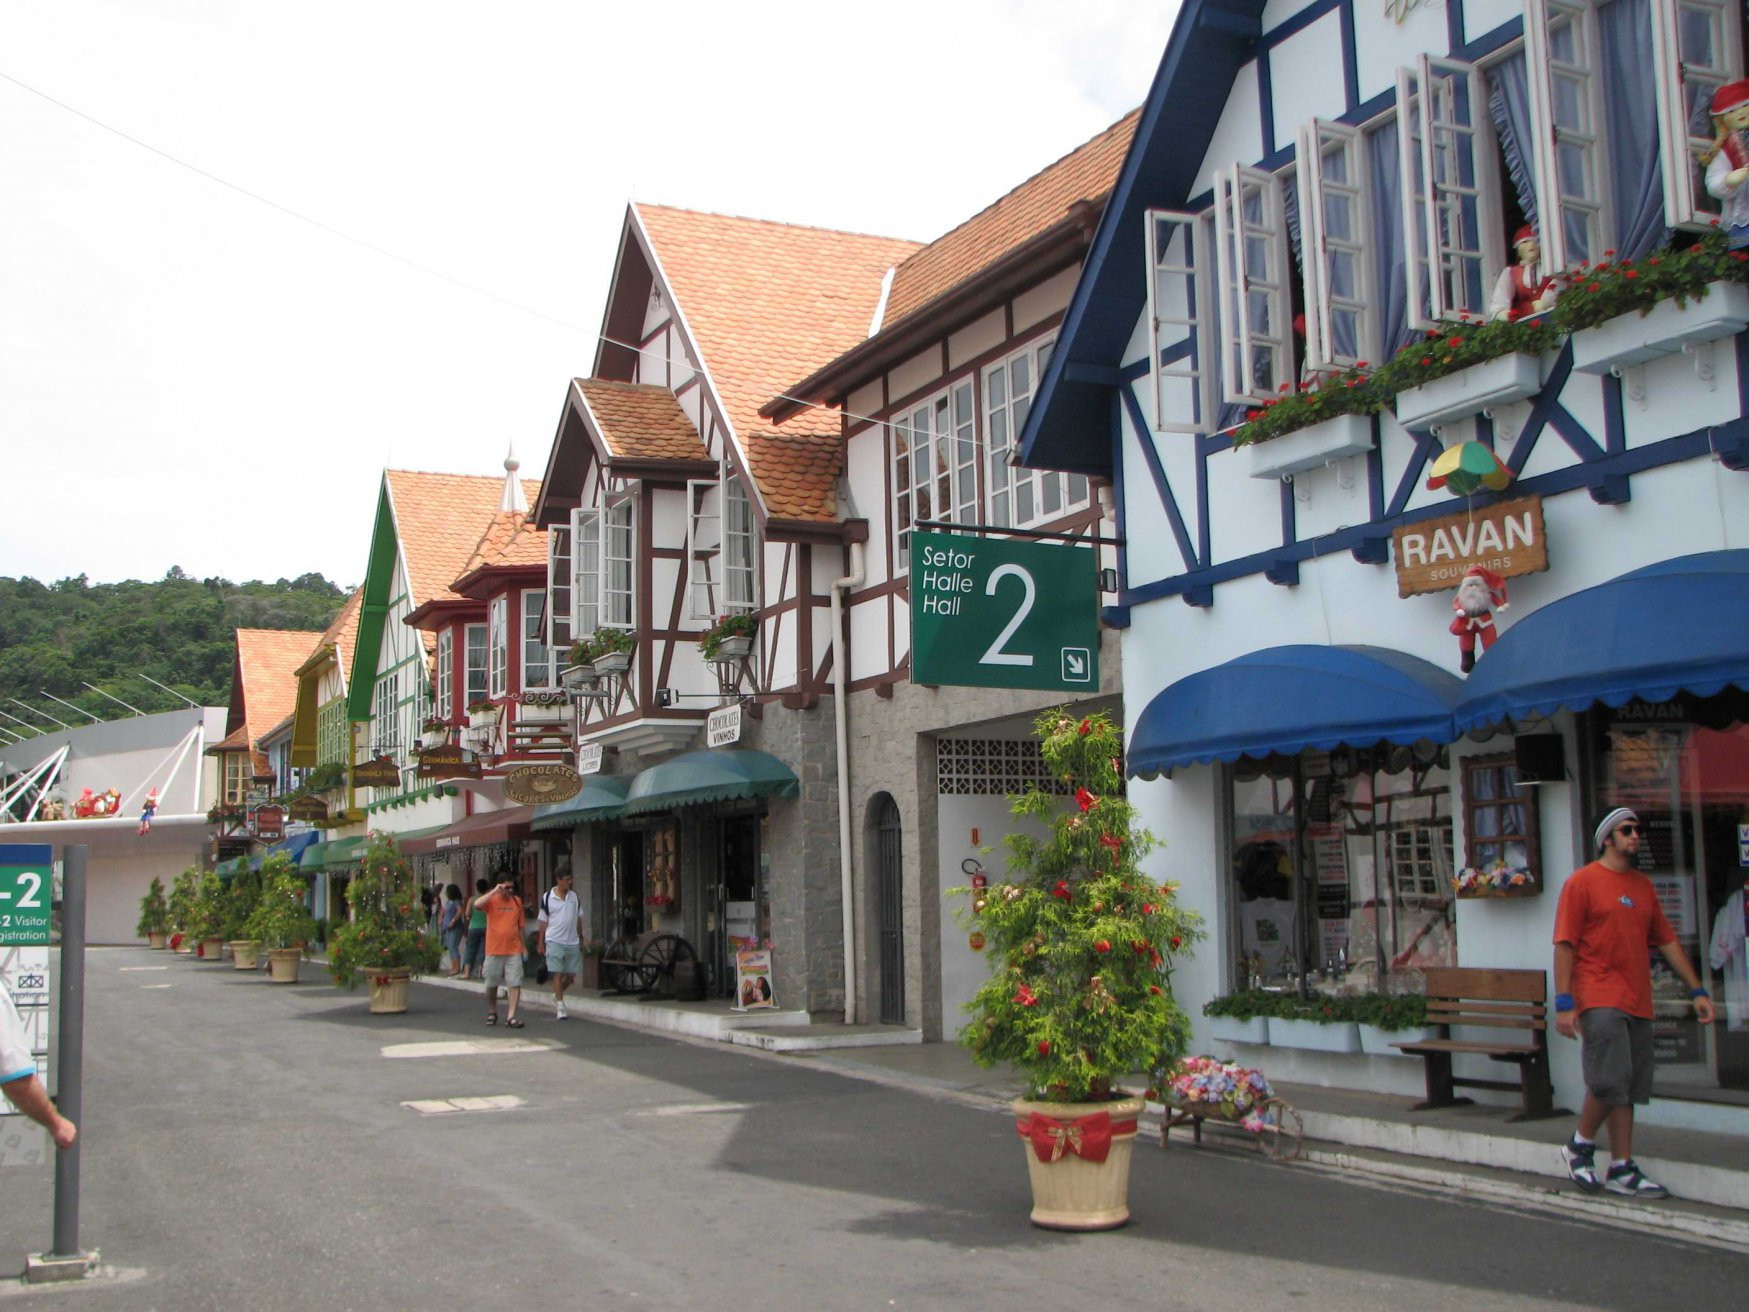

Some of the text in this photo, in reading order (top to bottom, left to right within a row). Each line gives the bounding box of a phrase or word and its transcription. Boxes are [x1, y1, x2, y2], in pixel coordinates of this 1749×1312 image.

[1401, 511, 1533, 569] RAVAN
[922, 546, 975, 569] Setor
[922, 570, 973, 593] Halle
[922, 594, 961, 616] Hall
[978, 563, 1036, 666] 2
[713, 728, 735, 745] VINHOS
[14, 914, 48, 927] Visitor
